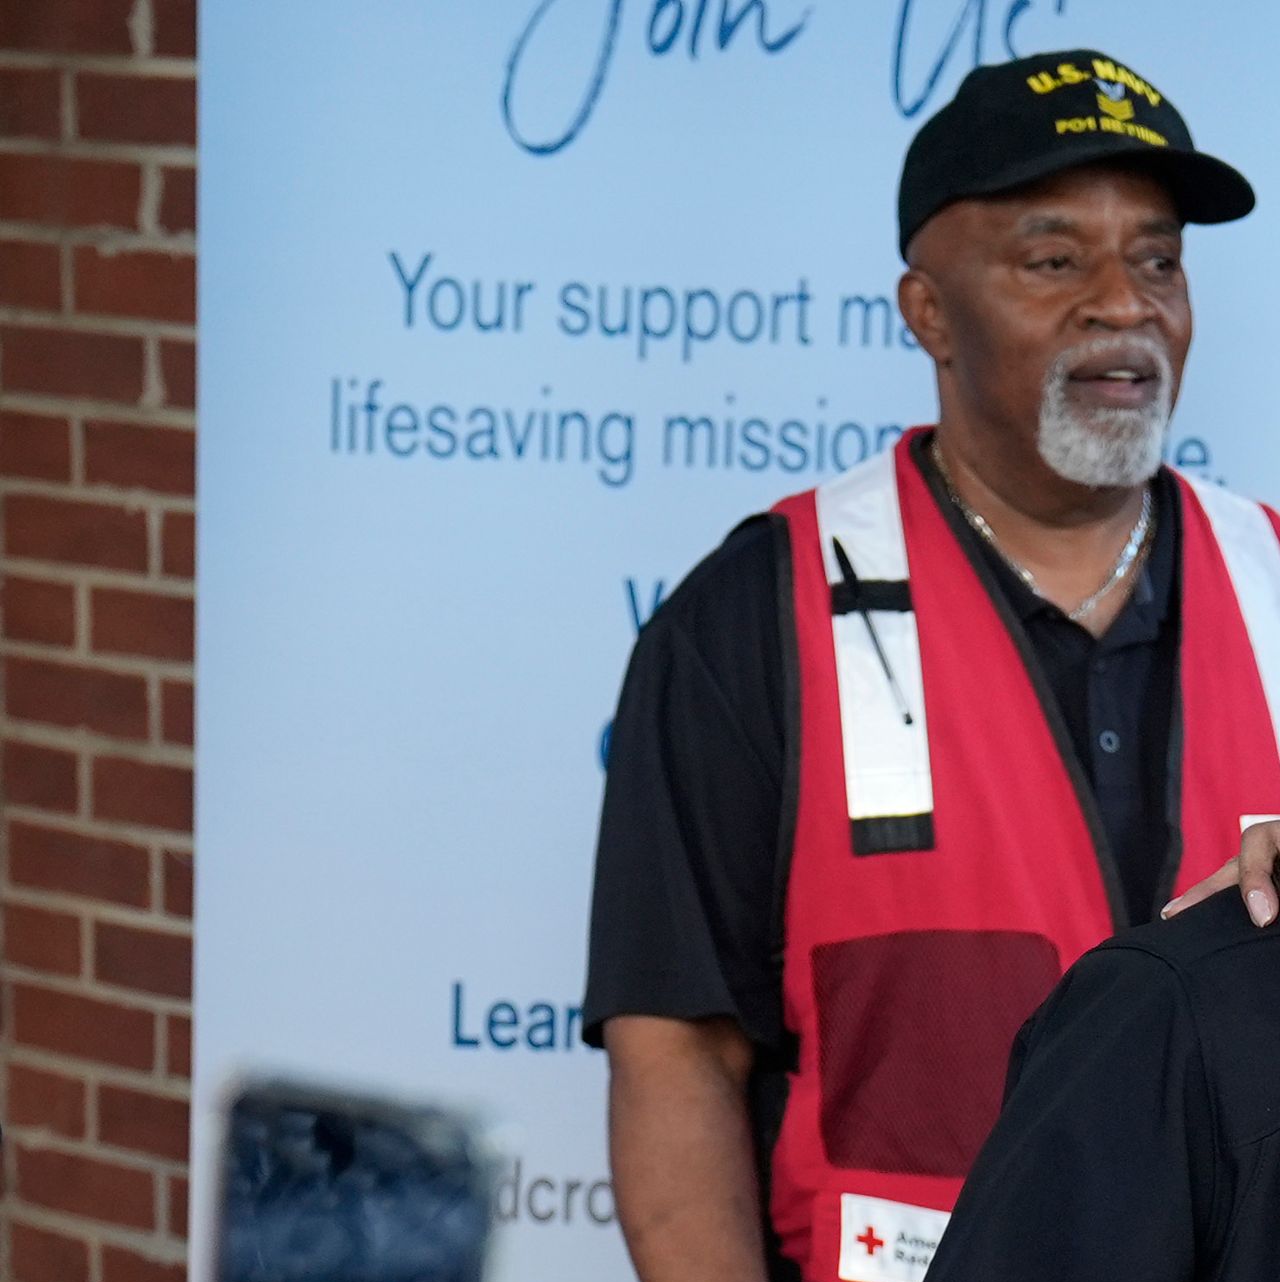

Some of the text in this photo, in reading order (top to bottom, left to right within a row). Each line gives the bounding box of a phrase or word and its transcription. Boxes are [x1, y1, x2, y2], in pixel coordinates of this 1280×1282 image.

[1026, 62, 1092, 95] U.S.
[388, 251, 535, 331] Your
[558, 278, 813, 363] support
[330, 378, 633, 488] lifesaving
